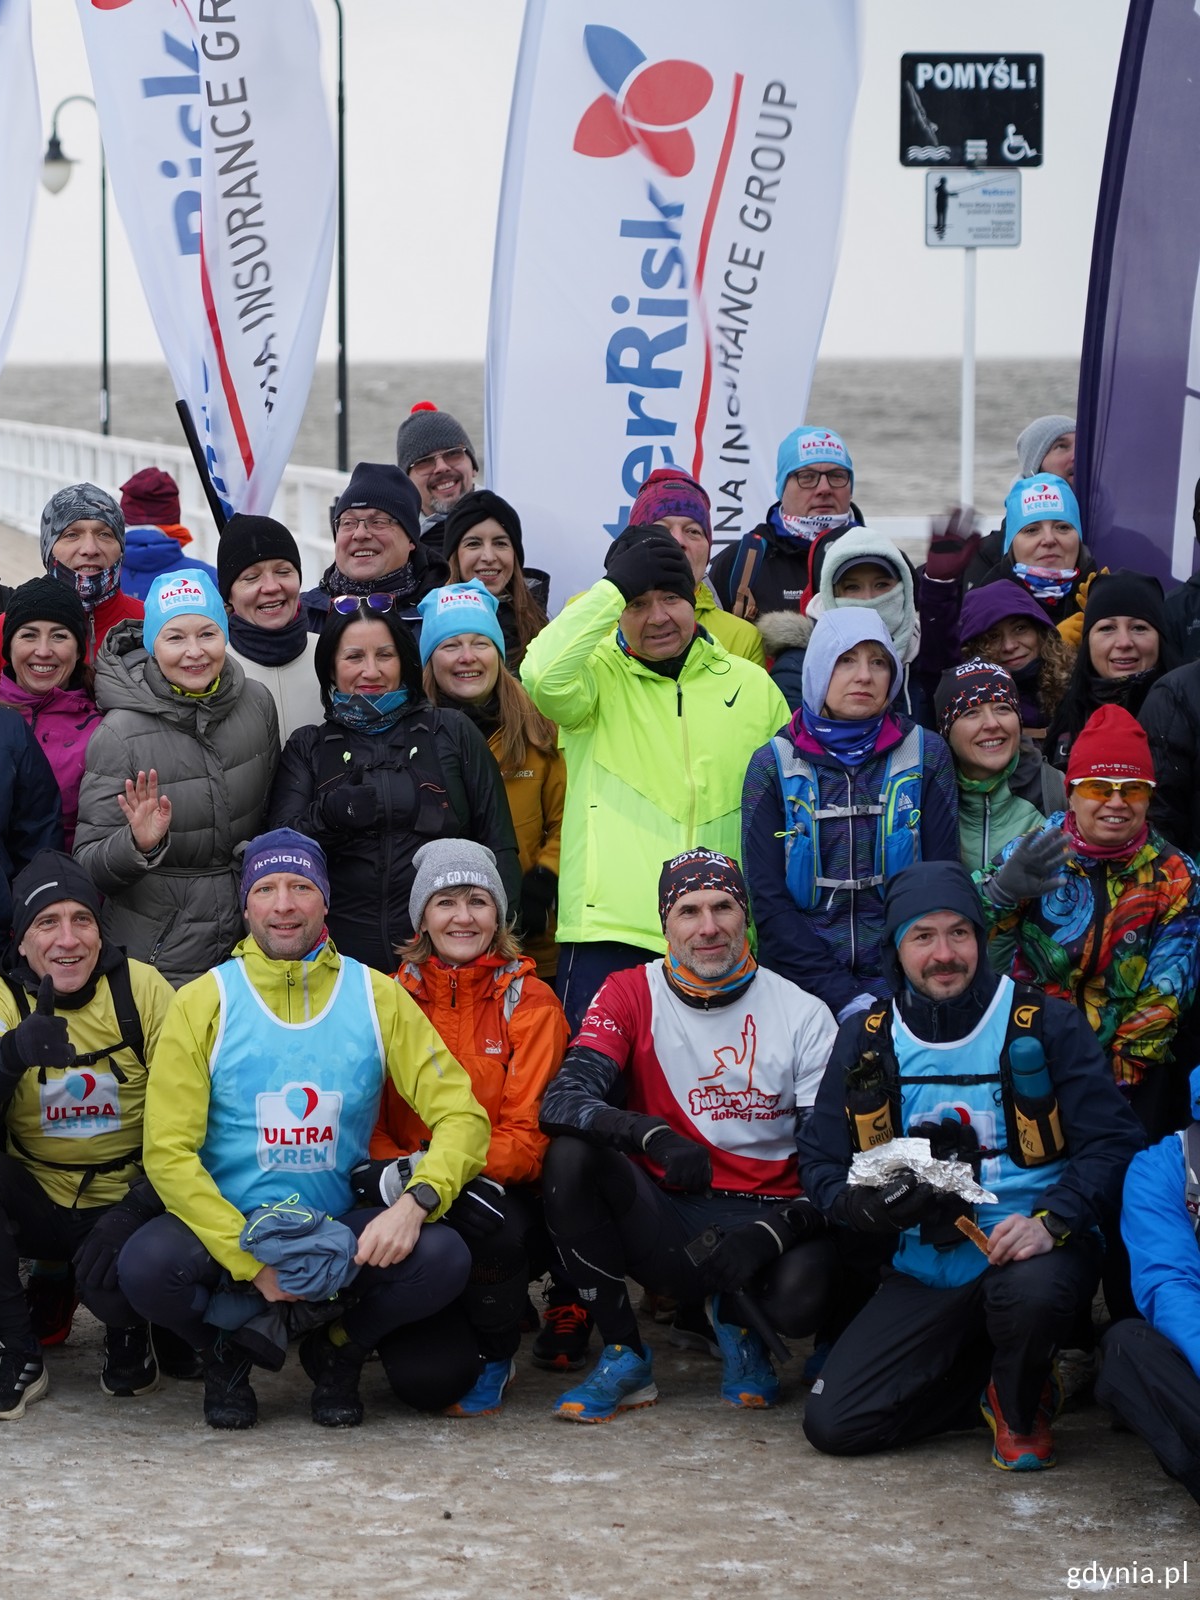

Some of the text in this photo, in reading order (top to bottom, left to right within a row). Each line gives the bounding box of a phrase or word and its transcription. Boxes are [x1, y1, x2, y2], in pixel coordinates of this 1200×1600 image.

[917, 57, 1037, 90] POMYŚL!
[739, 80, 798, 234] GROUP
[205, 76, 276, 334] INSURANCE
[802, 441, 843, 452] ULTRA
[1023, 493, 1060, 504] ULTRA
[161, 587, 202, 600] ULTRA
[440, 594, 481, 603] ULTRA
[669, 851, 727, 869] GDYNIA
[46, 1103, 116, 1121] ULTRA
[711, 1108, 753, 1122] dobrej
[263, 1125, 334, 1146] ULTRA
[267, 1145, 328, 1165] KREW
[884, 1183, 910, 1205] reusch
